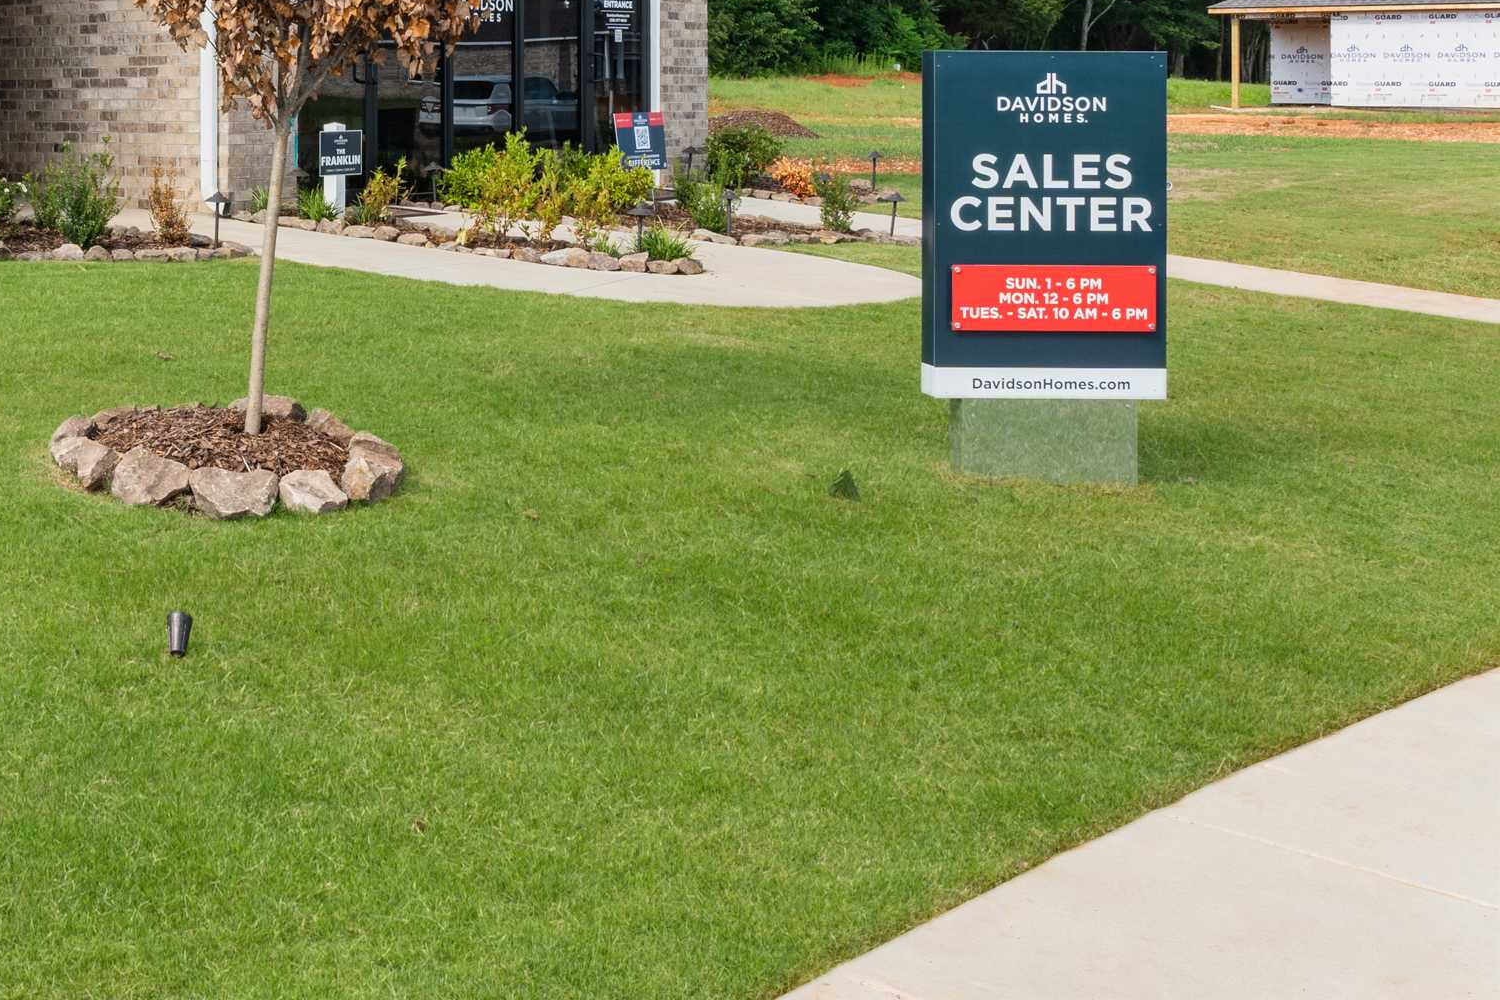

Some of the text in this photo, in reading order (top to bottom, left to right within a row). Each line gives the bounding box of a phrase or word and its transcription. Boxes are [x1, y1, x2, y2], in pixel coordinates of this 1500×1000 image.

[603, 0, 633, 9] ENTRANCE
[996, 96, 1107, 112] DAVIDSON
[1019, 113, 1089, 123] HOMES.
[321, 155, 361, 166] FRANKLIN
[971, 153, 1133, 190] SALES
[950, 196, 1153, 233] CENTER
[1005, 277, 1041, 290] SUN.
[1045, 278, 1051, 290] 1
[1066, 278, 1076, 290] 6
[1080, 278, 1102, 290] PM
[999, 292, 1039, 305] MON.
[1043, 293, 1059, 305] 12
[1072, 293, 1082, 305] 6
[1087, 293, 1109, 305] PM
[960, 307, 1003, 319] TUES.
[1017, 307, 1048, 319] SAT.
[1052, 308, 1069, 319] 10
[1073, 308, 1097, 319] AM
[1111, 308, 1121, 320] 6
[1126, 308, 1148, 320] PM
[972, 377, 1131, 391] DavidsonHomes.com
